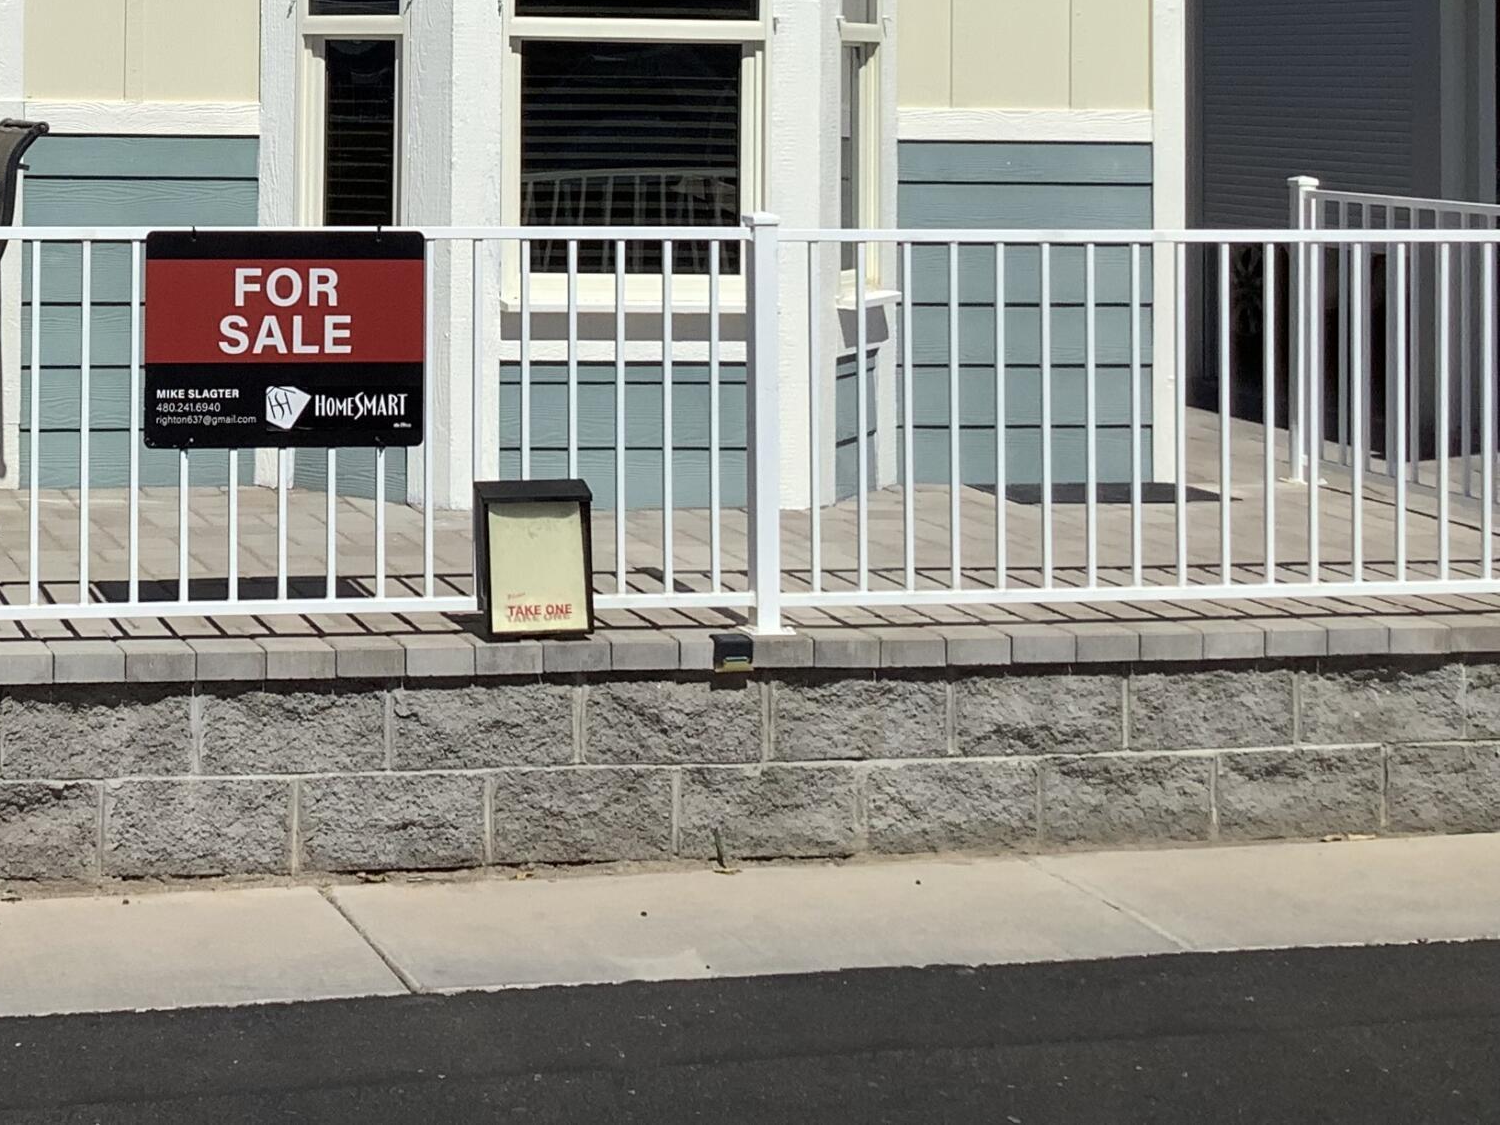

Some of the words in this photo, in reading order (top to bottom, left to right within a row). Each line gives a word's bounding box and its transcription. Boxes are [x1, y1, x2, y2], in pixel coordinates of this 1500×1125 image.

[234, 267, 339, 307] FOR
[218, 315, 352, 355] SALE
[156, 388, 186, 399] MIKE
[188, 388, 240, 399] SLAGTER
[155, 402, 221, 413] 480.241.6940
[155, 414, 257, 426] righton637@gmail.com
[507, 605, 542, 617] TAKE
[545, 603, 573, 615] ONE
